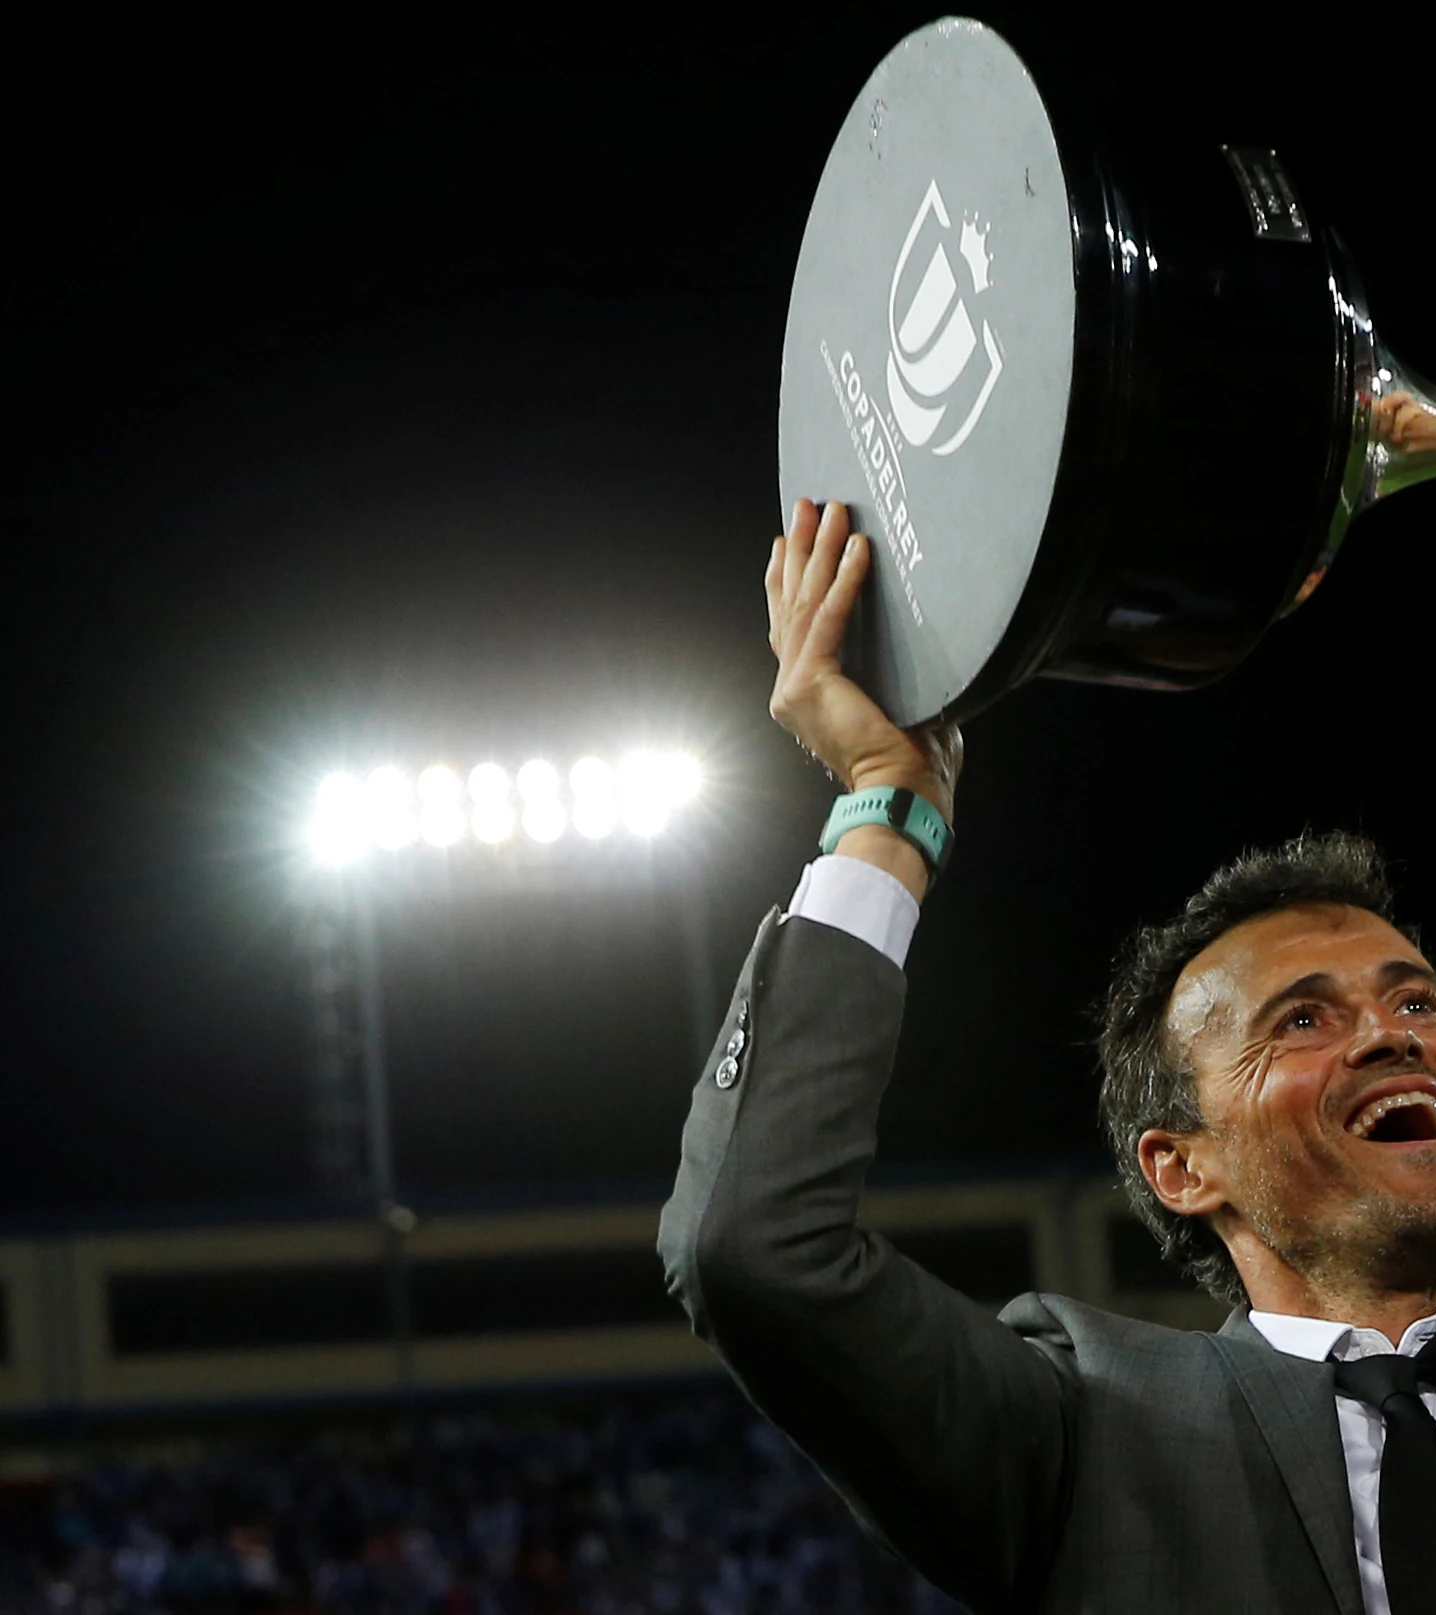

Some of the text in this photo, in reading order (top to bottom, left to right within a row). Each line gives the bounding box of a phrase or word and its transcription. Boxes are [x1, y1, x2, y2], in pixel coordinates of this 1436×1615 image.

[840, 350, 875, 449] COPA
[871, 436, 897, 513] DEL
[893, 499, 922, 571] REY
